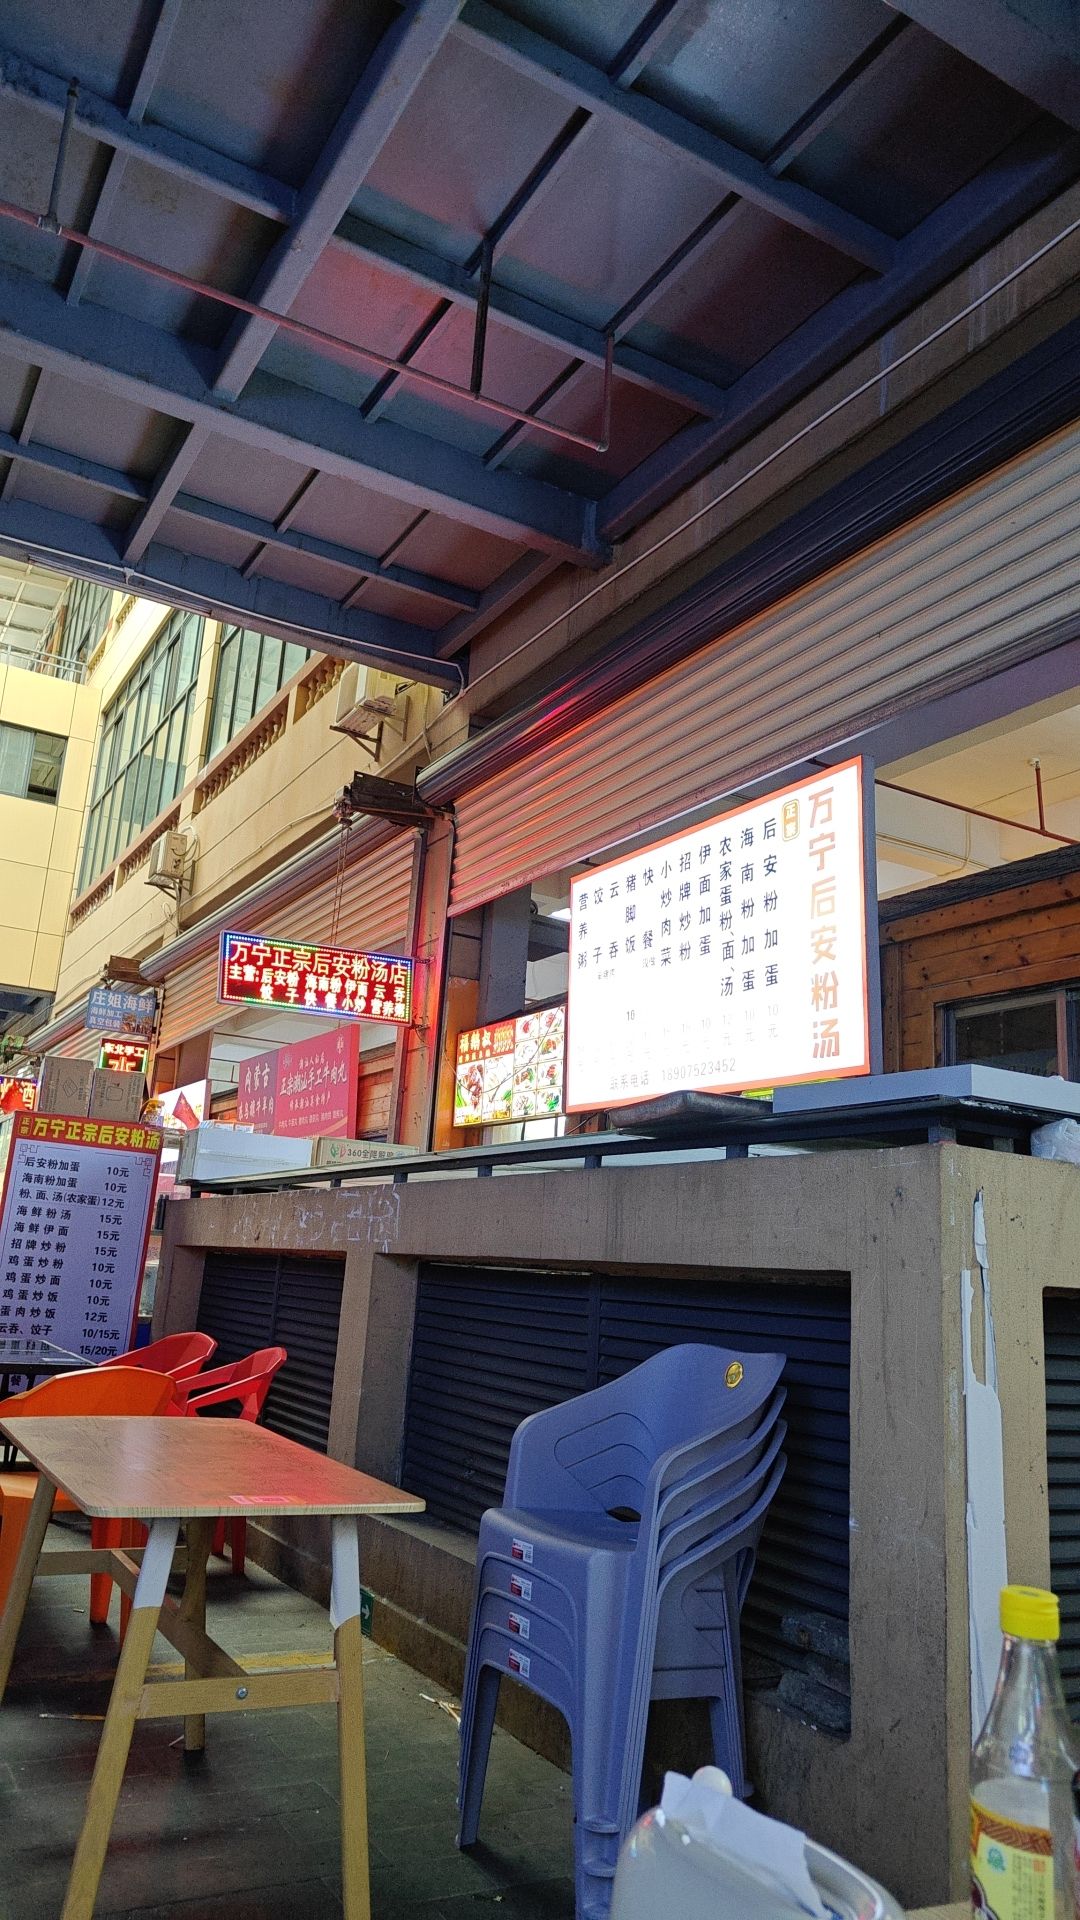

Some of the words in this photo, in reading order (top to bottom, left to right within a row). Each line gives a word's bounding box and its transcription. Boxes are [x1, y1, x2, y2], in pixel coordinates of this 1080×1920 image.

[642, 868, 655, 950] 快餐
[678, 852, 692, 961] 招牌炒粉
[699, 845, 712, 957] 伊面加蛋
[740, 826, 756, 992] 海南粉加蛋
[762, 818, 779, 987] 后安粉加蛋
[592, 887, 604, 964] 饺子
[608, 881, 620, 959] 云吞
[625, 874, 637, 955] 猪脚饭
[660, 860, 673, 967] 小炒肉菜
[808, 786, 840, 1060] 万宁后安粉汤
[577, 893, 589, 970] 营养粥
[230, 940, 407, 986] 万宁正宗后安粉汤店
[91, 991, 153, 1013] 庄姐海鲜
[661, 1058, 736, 1082] 18907523452
[32, 1117, 160, 1149] 万宁正宗后安粉汤
[24, 1157, 80, 1172] 后安粉加蛋
[106, 1166, 130, 1178] 10元
[22, 1172, 78, 1188] 海南粉加蛋
[104, 1182, 128, 1194] 10元
[102, 1197, 125, 1209] 12元
[16, 1205, 71, 1220] 海鲜粉汤
[99, 1214, 122, 1226] 15元
[13, 1222, 69, 1237] 海鲜伊面
[97, 1230, 120, 1241] 15元
[11, 1238, 66, 1253] 招牌炒粉
[94, 1246, 118, 1257] 15元
[8, 1255, 63, 1270] 鸡蛋炒粉
[92, 1262, 115, 1274] 10元
[5, 1272, 61, 1287] 鸡蛋炒面
[89, 1279, 113, 1290] 10元
[3, 1288, 58, 1303] 鸡蛋炒饭
[87, 1295, 110, 1307] 10元
[84, 1312, 108, 1323] 12元
[82, 1328, 120, 1341] 10/15元
[80, 1345, 118, 1357] 15/20元
